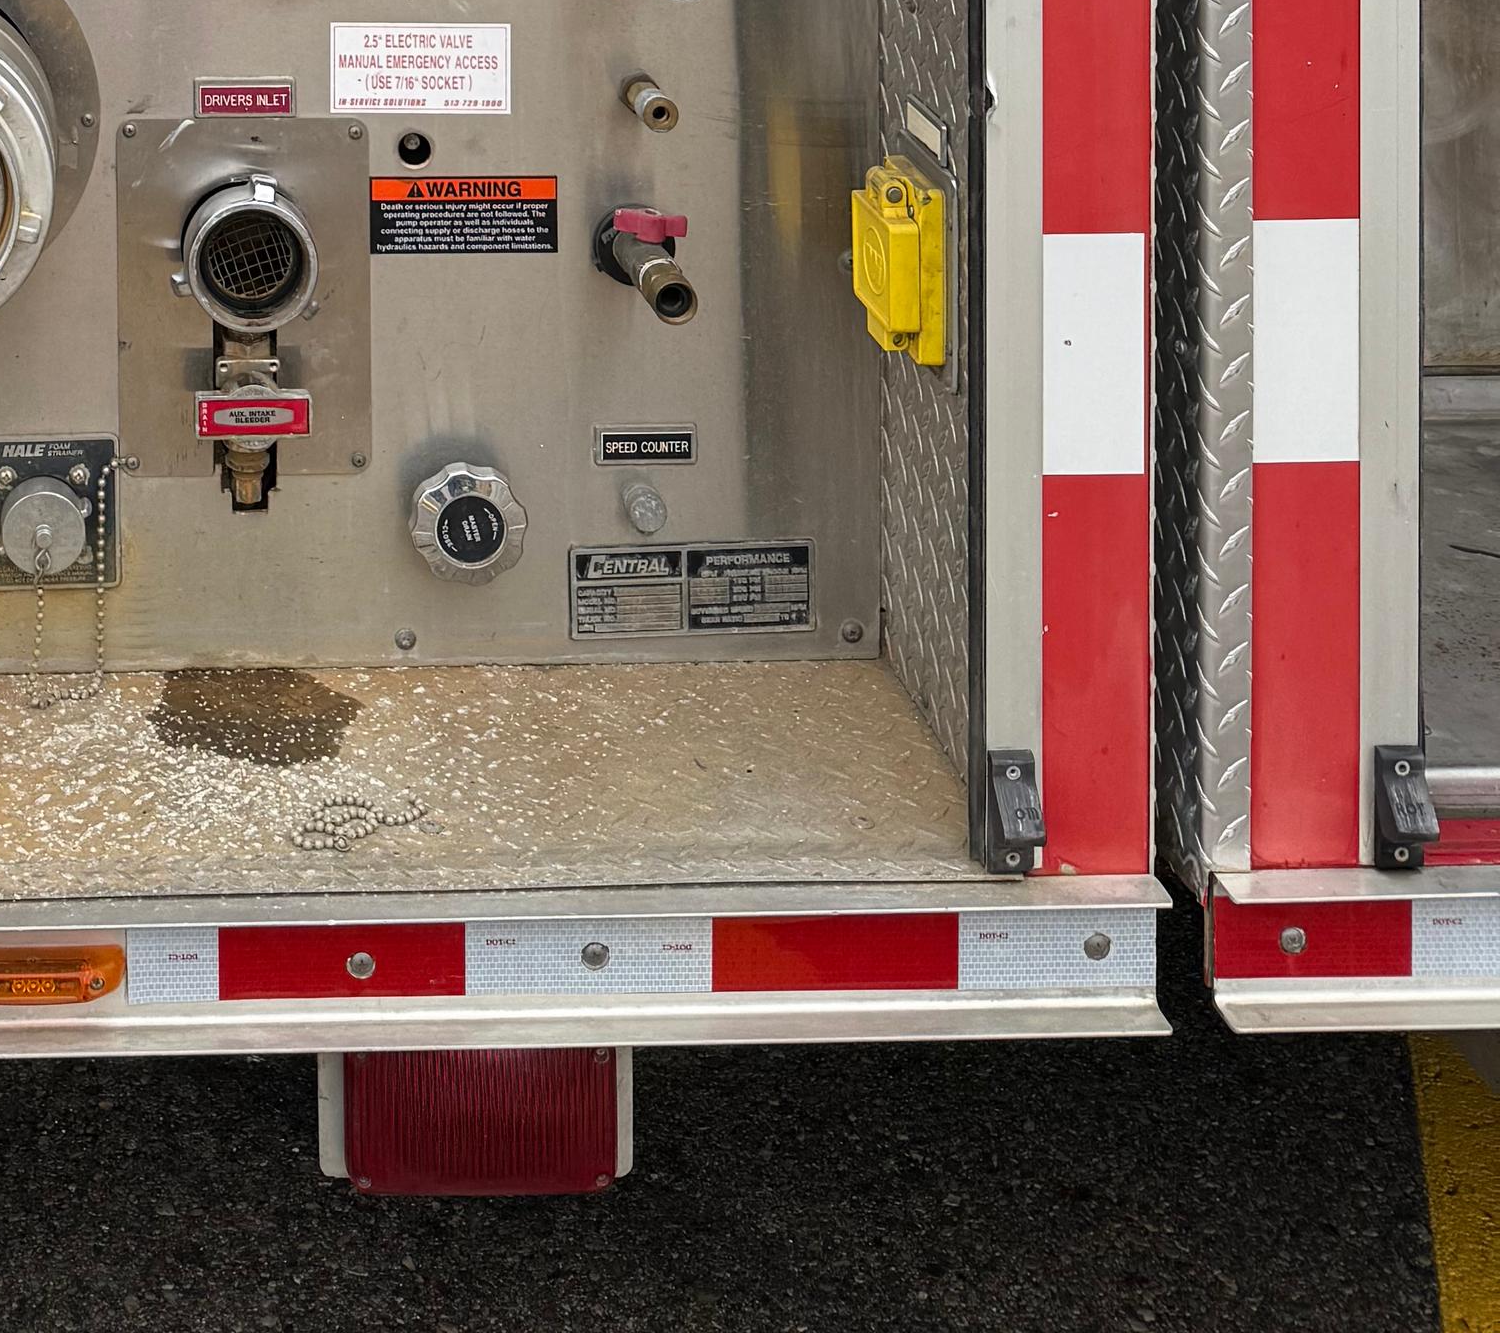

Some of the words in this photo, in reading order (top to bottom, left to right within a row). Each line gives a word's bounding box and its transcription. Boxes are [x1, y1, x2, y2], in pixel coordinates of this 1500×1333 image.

[385, 34, 436, 48] ELECTRIC
[440, 35, 473, 48] VALVE
[339, 55, 383, 69] MANUAL
[386, 55, 451, 69] EMERGENCY
[455, 55, 498, 70] ACCESS
[371, 76, 392, 90] USE
[421, 76, 466, 90] SOCKET
[204, 94, 252, 106] DRIVERS
[256, 93, 287, 106] INLET
[383, 98, 427, 107] SOLUTIONS
[426, 181, 521, 197] WARNING
[445, 203, 467, 211] injury
[383, 212, 420, 220] operating
[422, 211, 465, 219] procedures
[380, 227, 423, 235] connecting
[425, 227, 451, 235] supply
[463, 227, 500, 235] discharge
[376, 243, 417, 252] hydraulics
[466, 243, 510, 251] component
[3, 444, 46, 457] HALE
[605, 441, 638, 453] SPEED
[640, 441, 689, 452] COUNTER
[468, 515, 481, 542] MASTER
[706, 553, 790, 565] PERFORMANCE
[587, 555, 670, 578] CENTRAL
